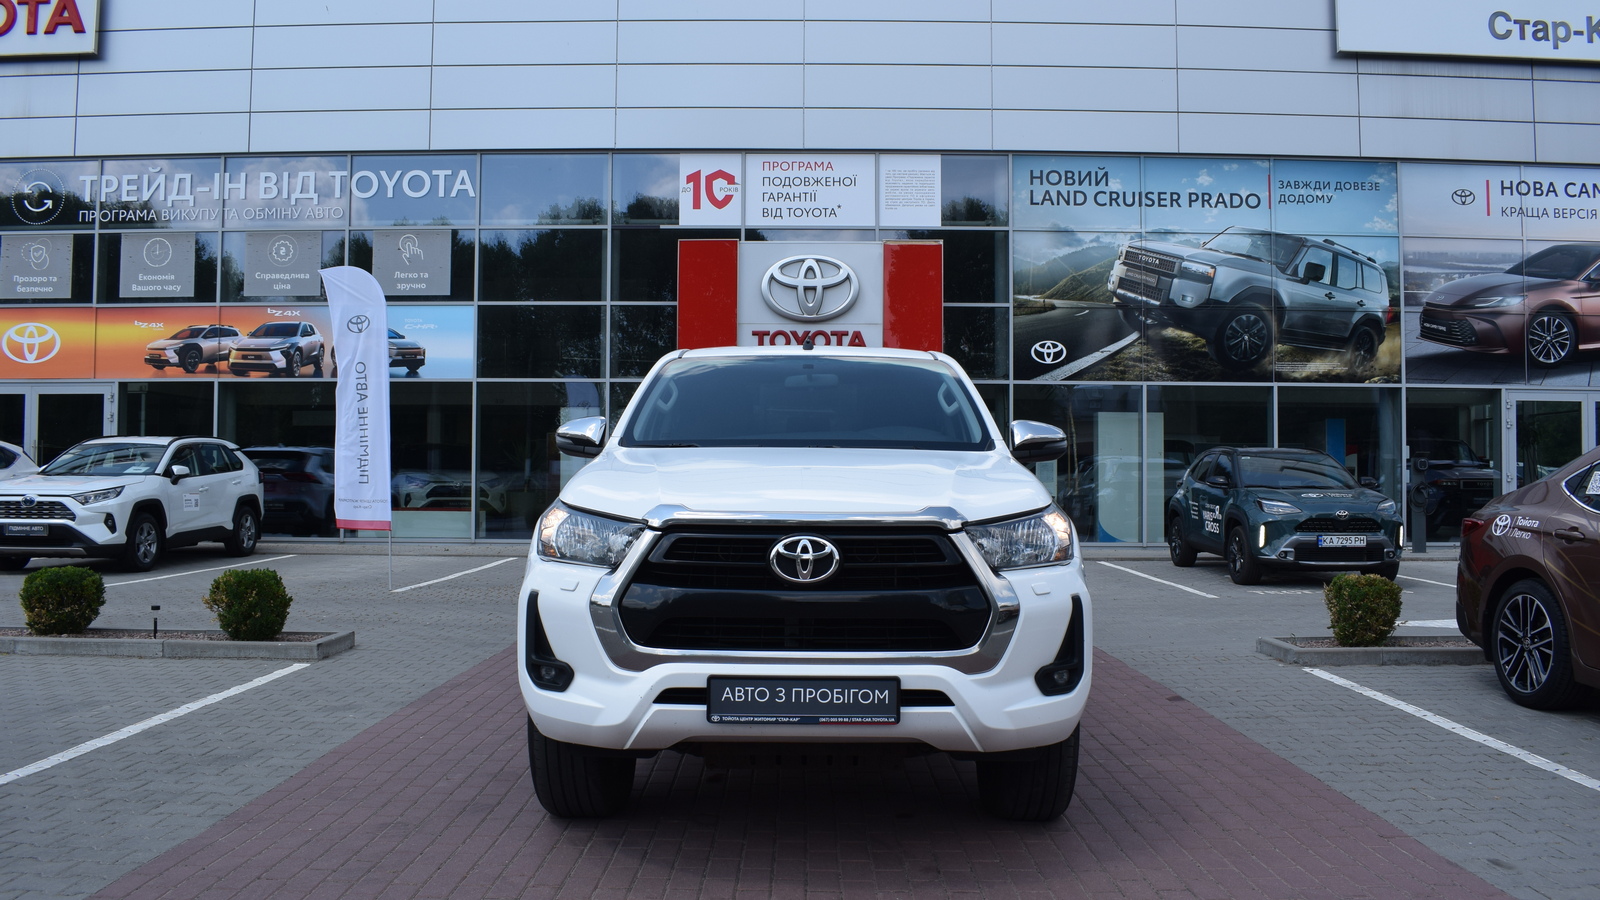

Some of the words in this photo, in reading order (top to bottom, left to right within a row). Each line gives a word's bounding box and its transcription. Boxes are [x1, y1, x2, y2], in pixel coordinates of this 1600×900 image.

[762, 161, 834, 172] ПРОГРАМА
[762, 174, 858, 188] ПОДОВЖЕНОЇ
[1030, 166, 1109, 187] НОВИЙ
[78, 166, 247, 207] ТРЕЙД-ІН
[259, 171, 318, 206] ВІД
[329, 169, 476, 198] TOYOTA
[1278, 180, 1330, 191] ЗАВЖДИ
[1334, 181, 1380, 192] ДОВЕЗЕ
[1500, 180, 1559, 198] НОВА
[762, 190, 817, 202] ГАРАНТІЇ
[1030, 190, 1088, 206] LAND
[1093, 190, 1182, 208] CRUISER
[1188, 192, 1262, 209] PRADO
[1278, 194, 1334, 205] ДОДОМУ
[78, 209, 157, 222] ПРОГРАМА
[161, 208, 220, 221] ВИКУПУ
[223, 208, 239, 220] ТА
[243, 207, 301, 220] ОБМІНУ
[305, 206, 344, 219] АВТО
[762, 208, 784, 220] ВІД
[1501, 206, 1550, 220] КРАЩА
[1553, 208, 1598, 220] ВЕРСІЯ
[1138, 255, 1160, 264] TOYOTA
[14, 275, 47, 284] Прозоро
[255, 272, 310, 280] Справедлива
[16, 285, 53, 293] безпечно
[132, 284, 160, 292] Вашого
[162, 284, 182, 292] часу
[273, 282, 291, 290] ціна
[396, 282, 426, 290] зручно
[752, 330, 866, 347] TOYOTA
[1205, 520, 1220, 534] CROSS
[1516, 516, 1540, 528] Тойота
[1322, 536, 1334, 544] KA
[1336, 536, 1353, 544] 7295
[1354, 536, 1365, 544] PH
[1510, 528, 1532, 540] Легко
[721, 687, 770, 702] АВТО
[792, 688, 889, 704] ПРОБІГОМ
